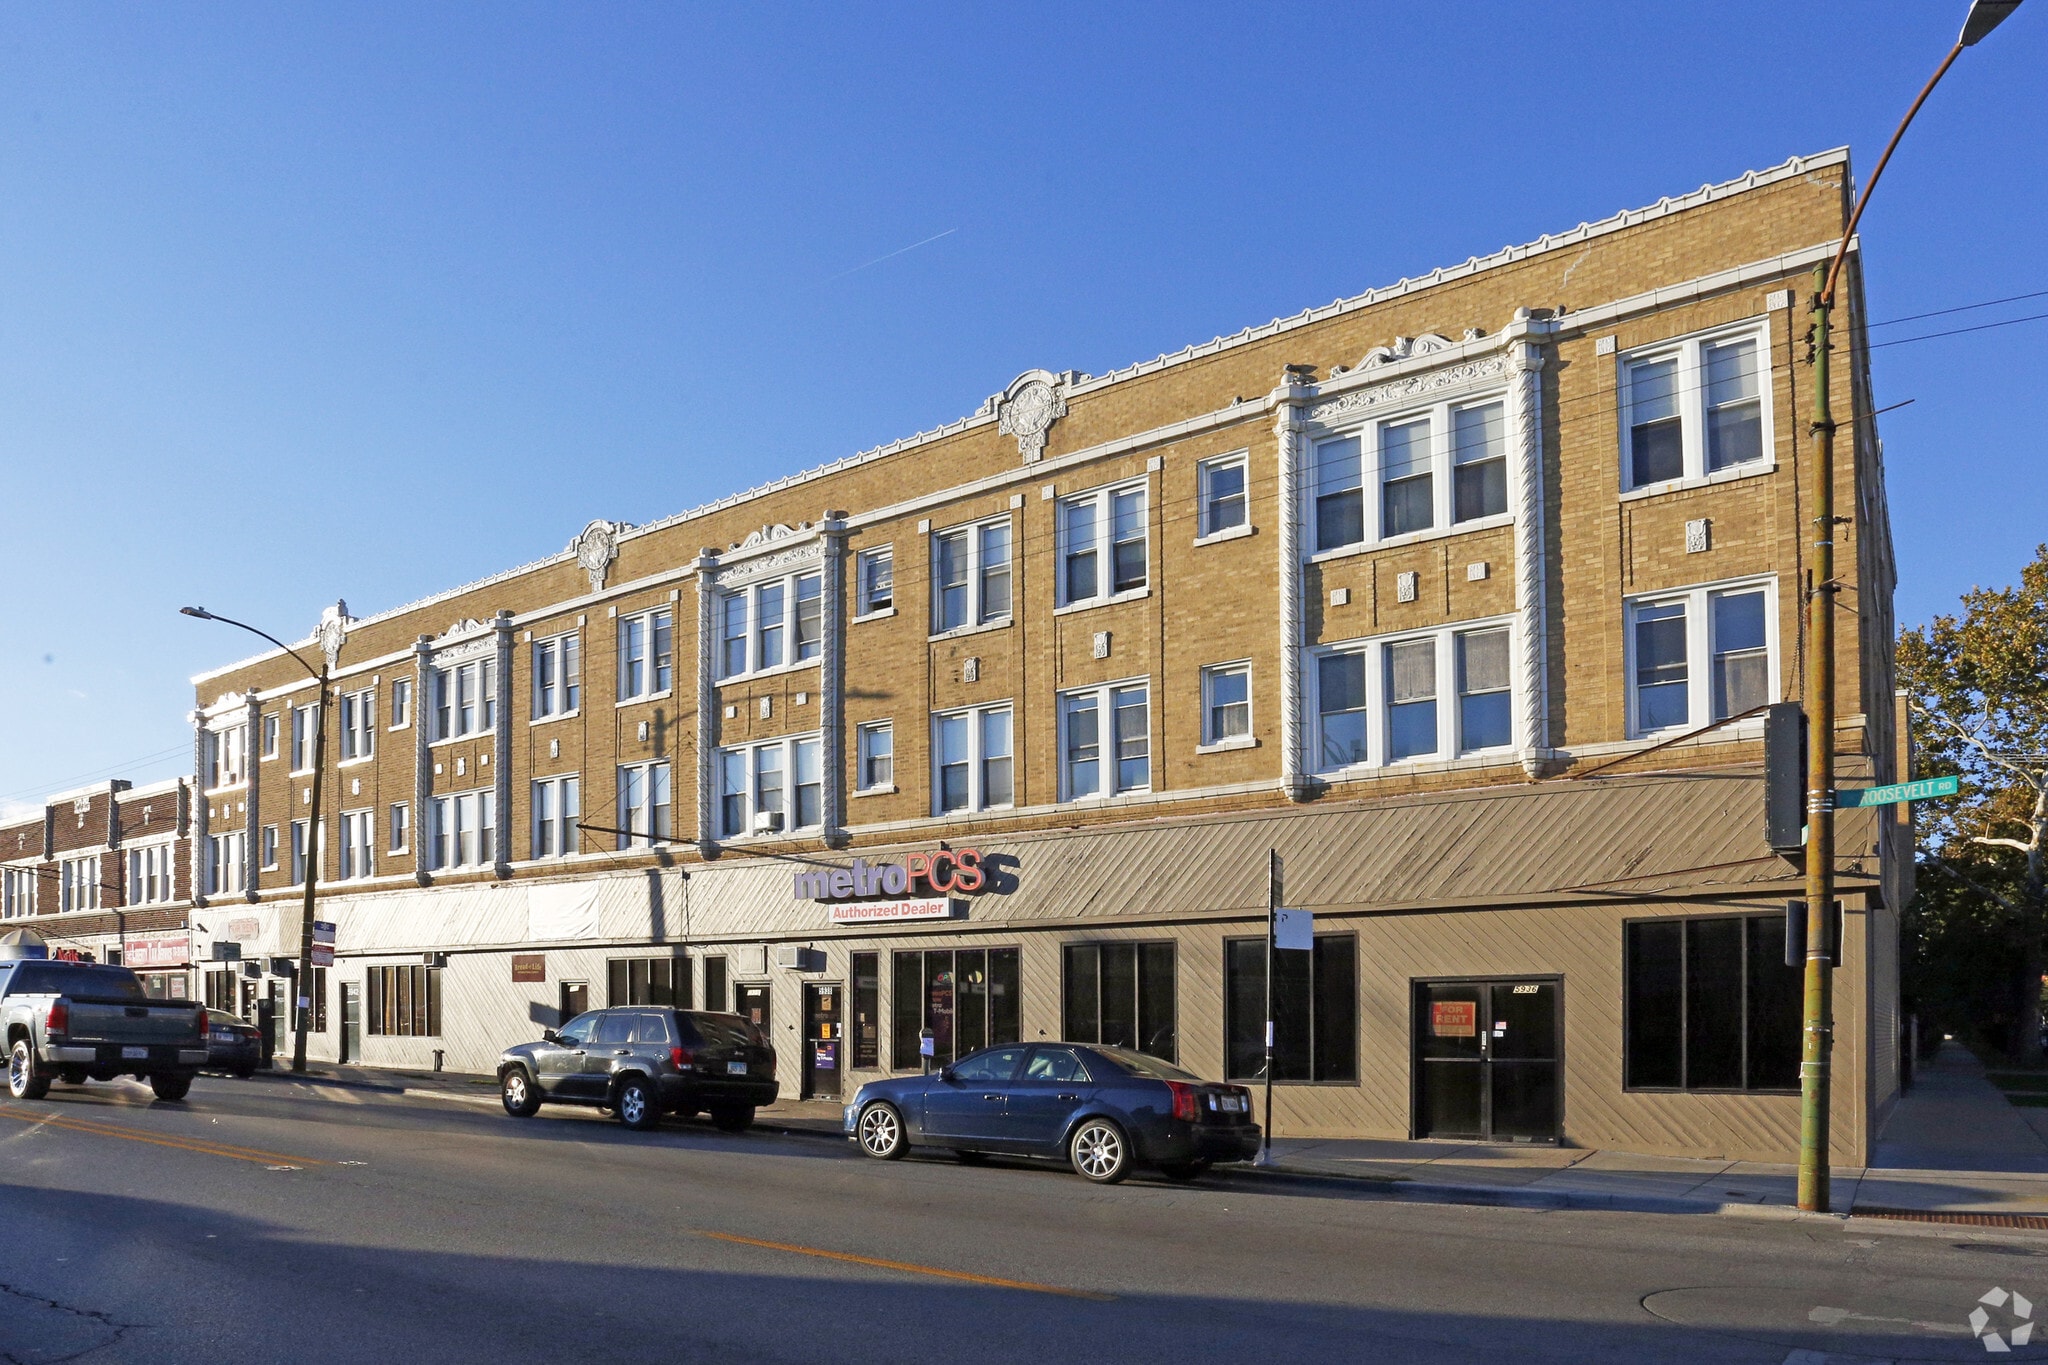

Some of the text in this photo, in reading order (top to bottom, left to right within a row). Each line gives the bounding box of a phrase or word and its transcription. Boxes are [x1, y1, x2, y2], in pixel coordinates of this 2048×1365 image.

[1861, 781, 1952, 804] ROOSEVELT RD
[794, 848, 986, 900] metroPCS
[833, 902, 944, 918] Authorized Dealer
[1515, 985, 1537, 993] 5936
[1442, 1005, 1464, 1014] FOR
[1436, 1014, 1468, 1024] RENT
